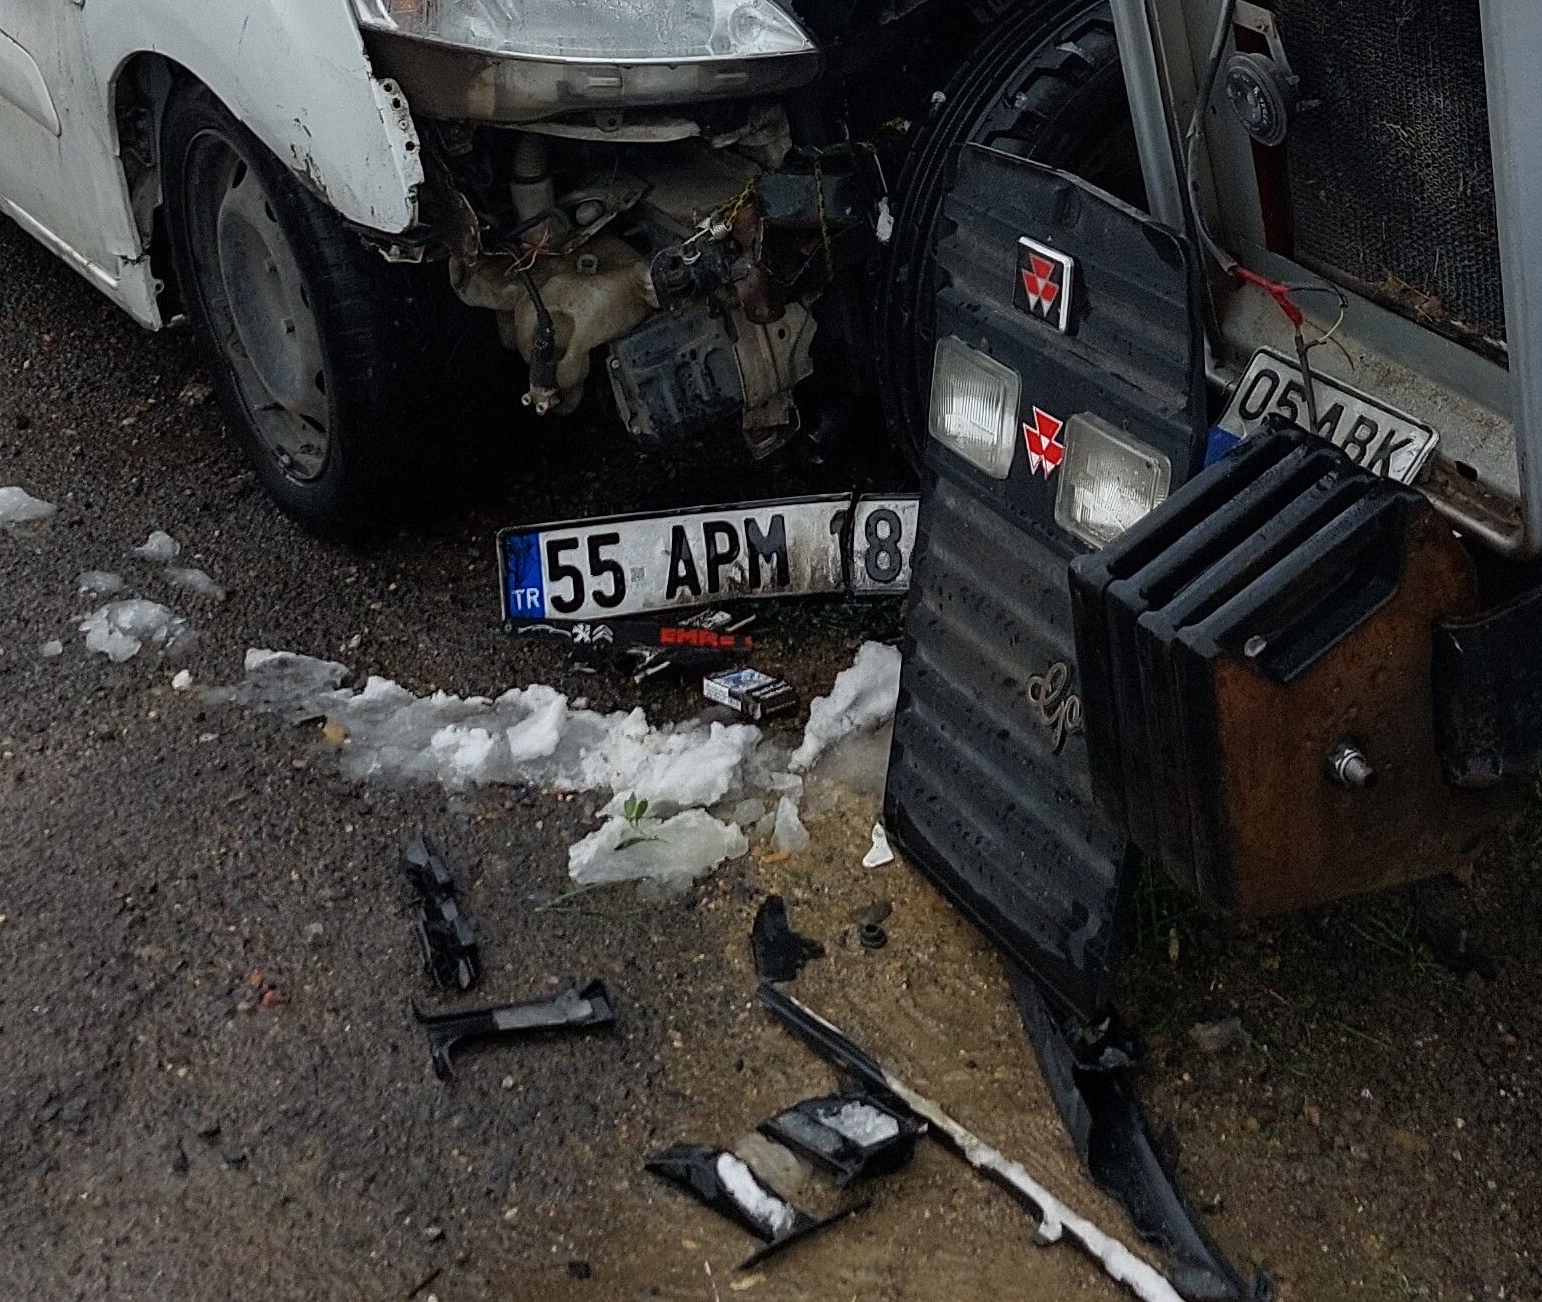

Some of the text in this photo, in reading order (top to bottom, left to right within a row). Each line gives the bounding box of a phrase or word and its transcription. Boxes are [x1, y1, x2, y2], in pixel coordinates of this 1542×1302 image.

[1238, 368, 1308, 423] 05
[545, 507, 914, 614] 55 APM 18
[511, 587, 541, 611] TR
